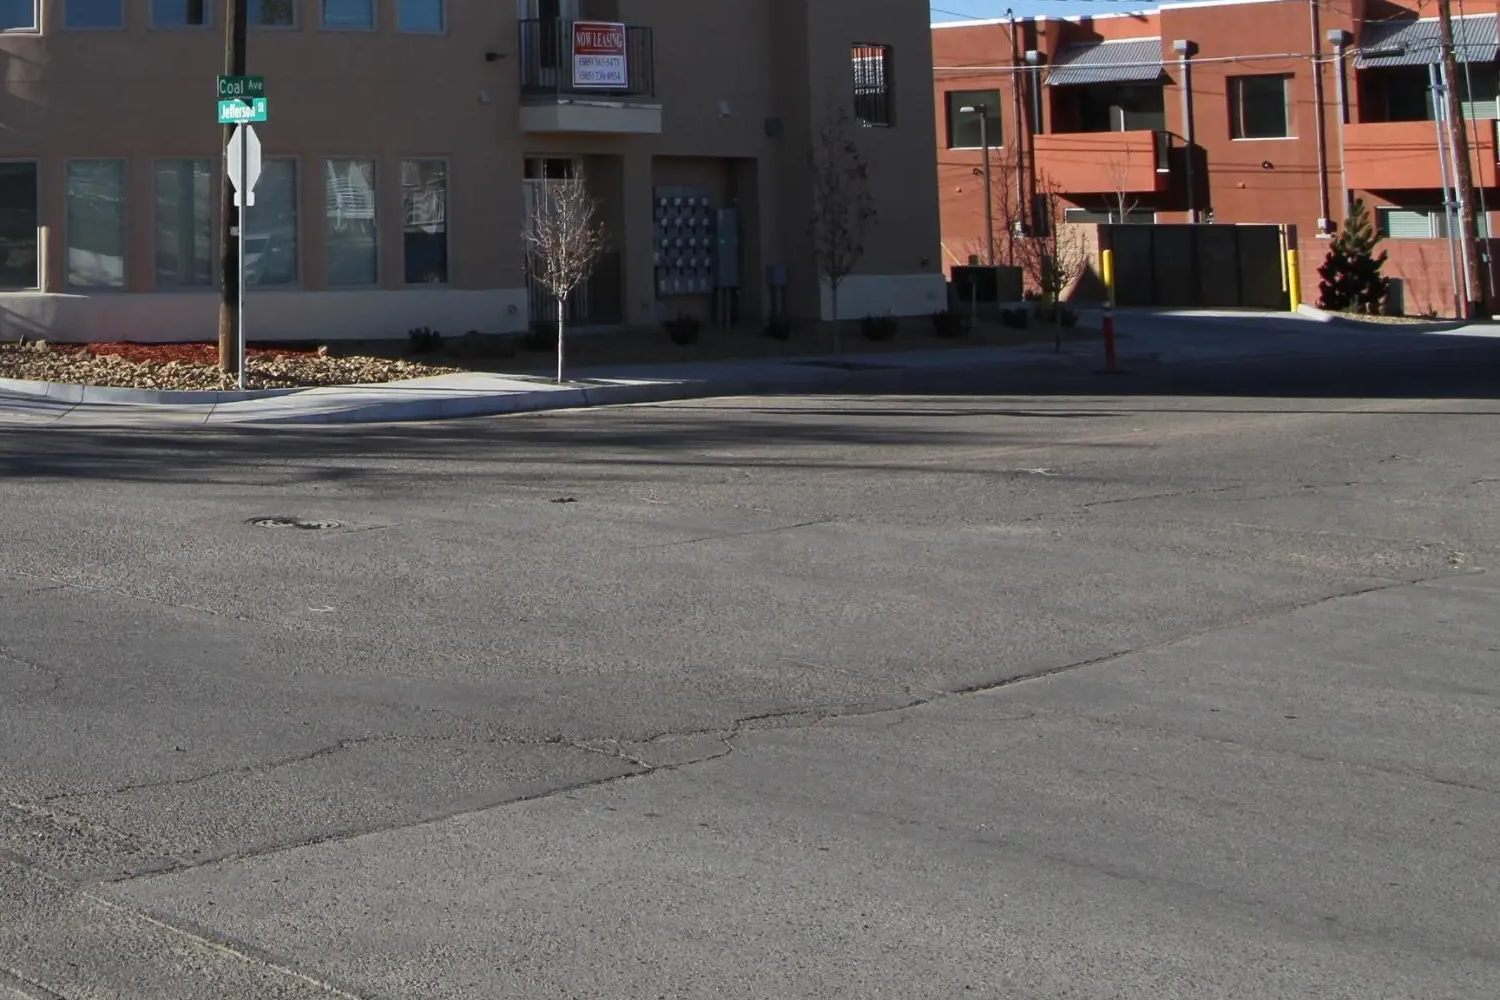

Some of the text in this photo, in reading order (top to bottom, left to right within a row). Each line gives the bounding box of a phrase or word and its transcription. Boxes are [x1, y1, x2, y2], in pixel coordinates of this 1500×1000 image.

[576, 31, 623, 48] NOW LEASING
[219, 79, 263, 94] Coal Ave
[220, 103, 256, 120] Jefferson
